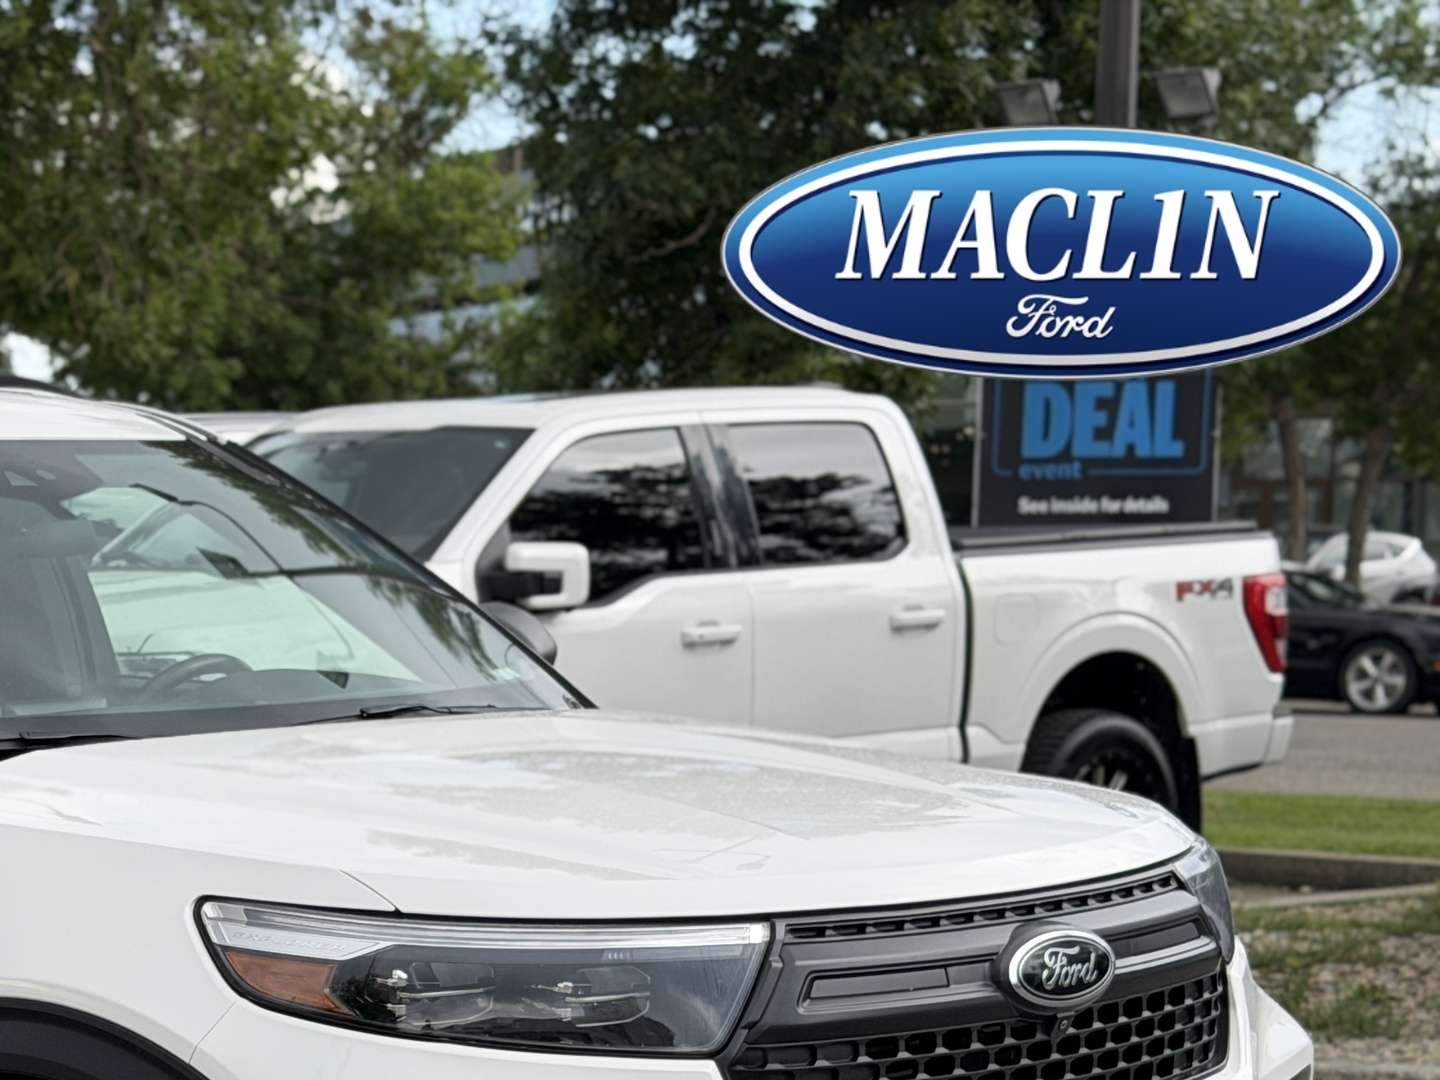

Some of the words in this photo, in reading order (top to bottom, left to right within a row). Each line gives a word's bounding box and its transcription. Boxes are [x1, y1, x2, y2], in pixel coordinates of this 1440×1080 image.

[1021, 377, 1185, 458] DEAL
[1017, 496, 1049, 514] See
[1050, 496, 1099, 514] inside
[1100, 495, 1123, 513] for
[1123, 495, 1170, 513] details
[1175, 578, 1234, 602] FX4
[1041, 945, 1099, 991] Ford
